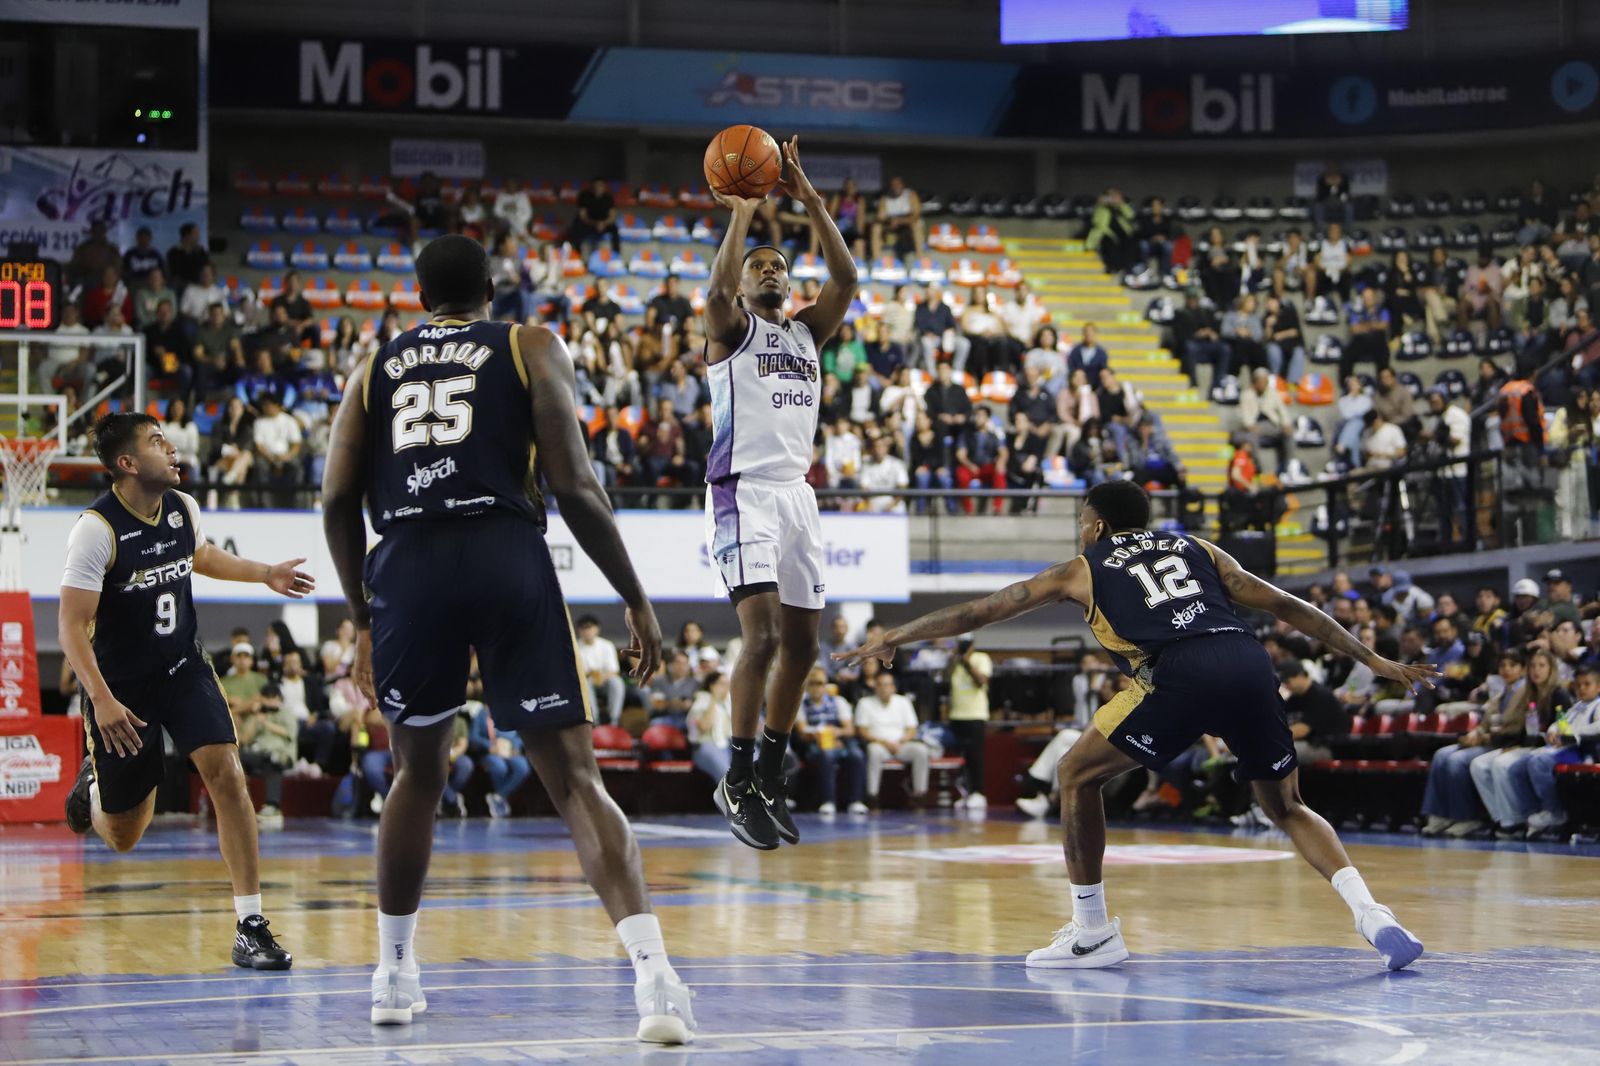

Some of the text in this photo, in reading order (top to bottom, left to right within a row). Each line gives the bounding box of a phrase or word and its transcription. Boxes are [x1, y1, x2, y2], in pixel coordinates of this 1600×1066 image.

[299, 40, 501, 110] Mobil
[707, 69, 905, 111] ASTROS
[1081, 72, 1275, 134] Mobil
[0, 281, 51, 328] 08
[384, 342, 494, 380] GORDON
[766, 333, 779, 348] 12
[392, 374, 477, 454] 25
[772, 389, 813, 409] gride
[123, 555, 193, 592] ASTROS
[1126, 554, 1204, 609] 12
[153, 591, 177, 637] 9
[0, 737, 36, 750] IGA
[0, 781, 38, 795] NBP
